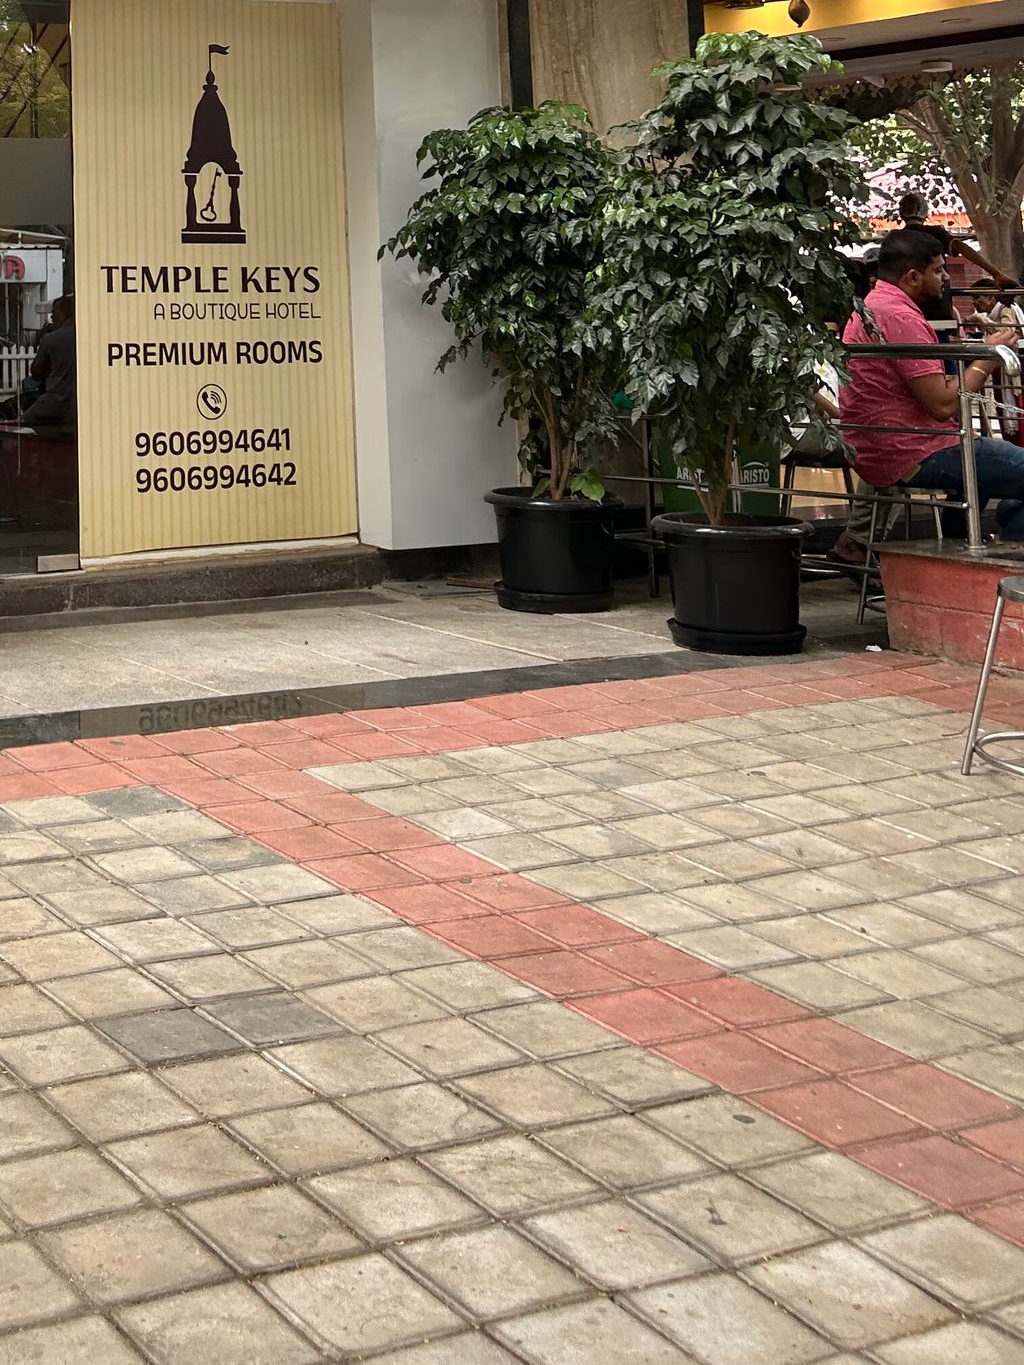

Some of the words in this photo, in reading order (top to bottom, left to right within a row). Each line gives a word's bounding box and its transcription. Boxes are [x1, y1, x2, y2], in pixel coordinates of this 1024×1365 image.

[100, 265, 229, 294] TEMPLE
[240, 265, 322, 294] KEYS
[153, 303, 166, 320] A
[170, 303, 261, 322] BOUTIQUE
[265, 302, 322, 320] HOTEL
[107, 342, 228, 367] PREMIUM
[236, 340, 324, 365] ROOMS
[134, 427, 292, 457] 9606994641
[136, 462, 298, 494] 9606994642
